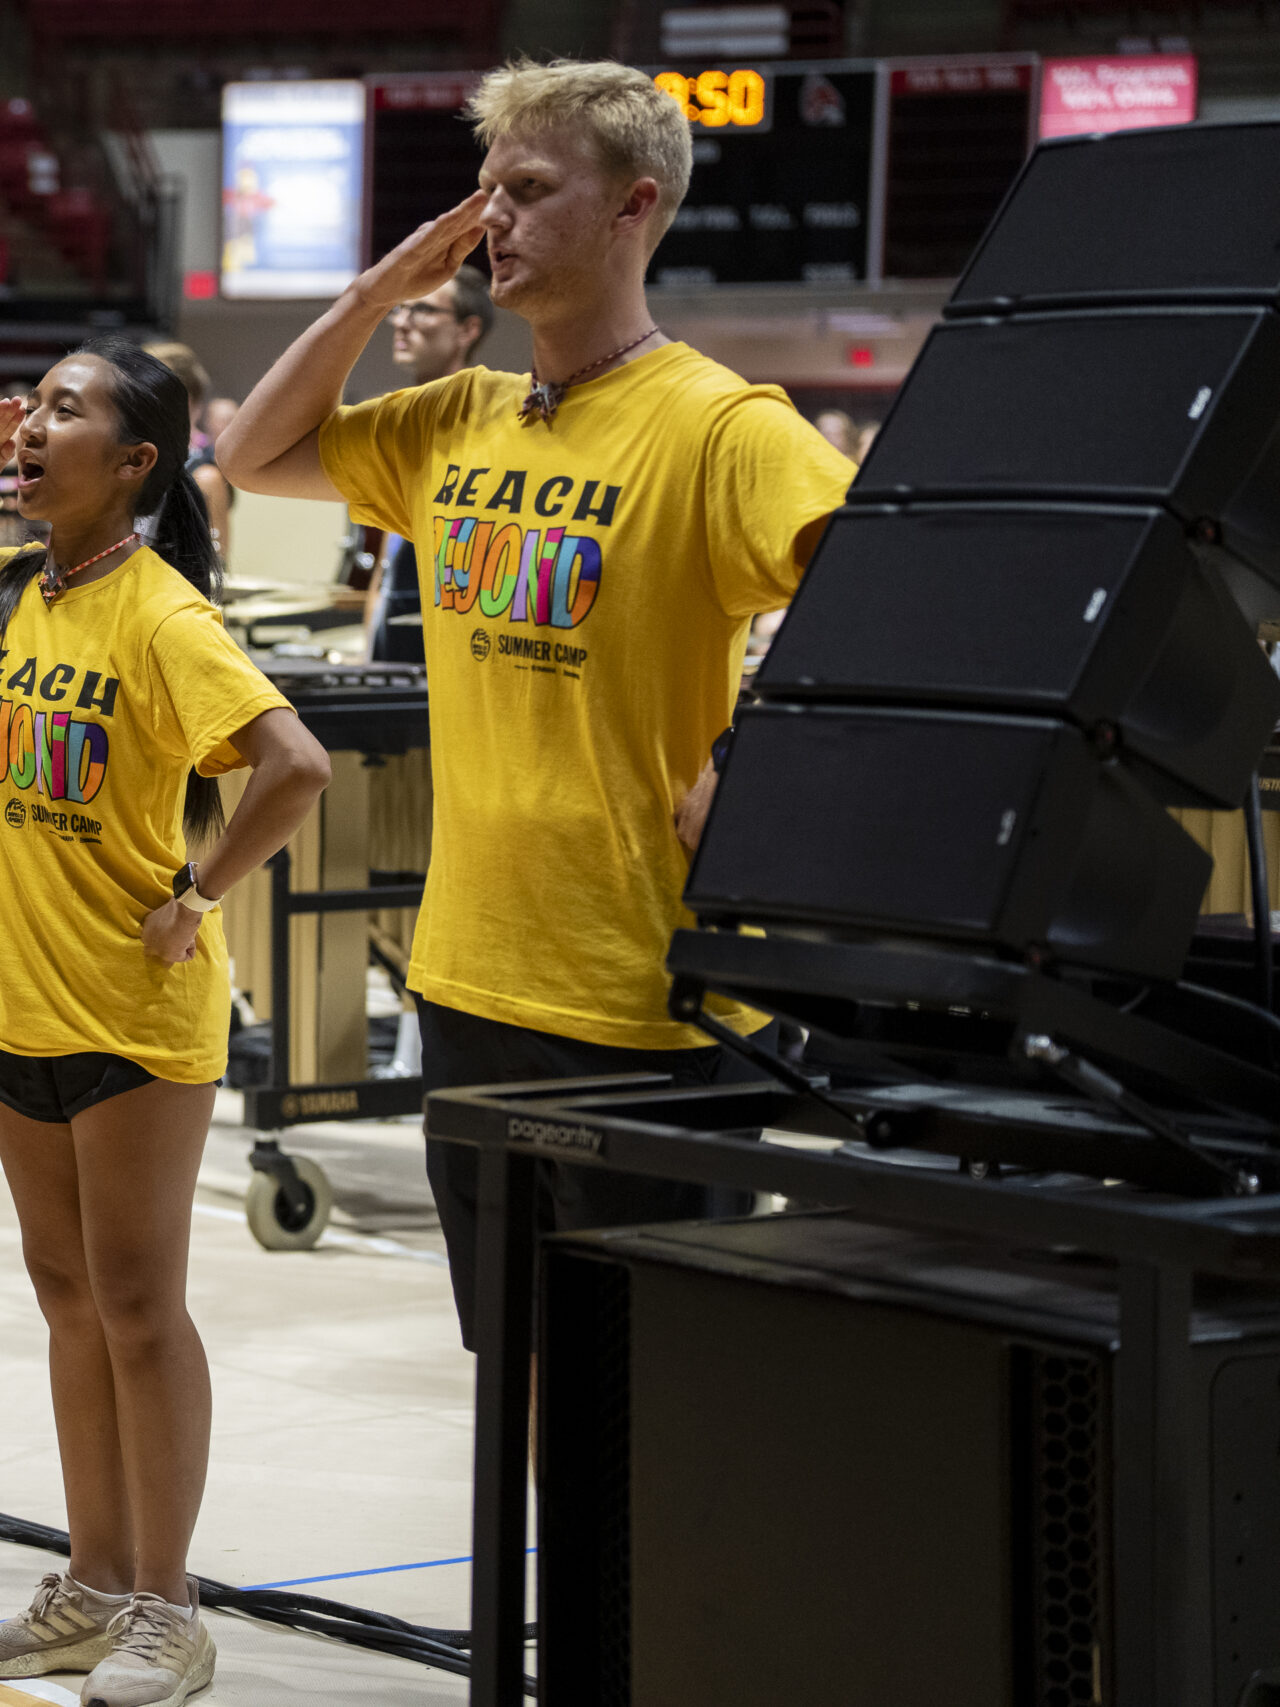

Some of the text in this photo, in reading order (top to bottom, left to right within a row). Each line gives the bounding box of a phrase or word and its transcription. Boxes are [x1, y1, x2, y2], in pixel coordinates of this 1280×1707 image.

[433, 515, 602, 630] EYOND
[497, 634, 551, 661] SUMMER
[554, 643, 587, 668] CAMP
[71, 813, 102, 836] CAMP
[508, 1117, 603, 1154] pageantry
